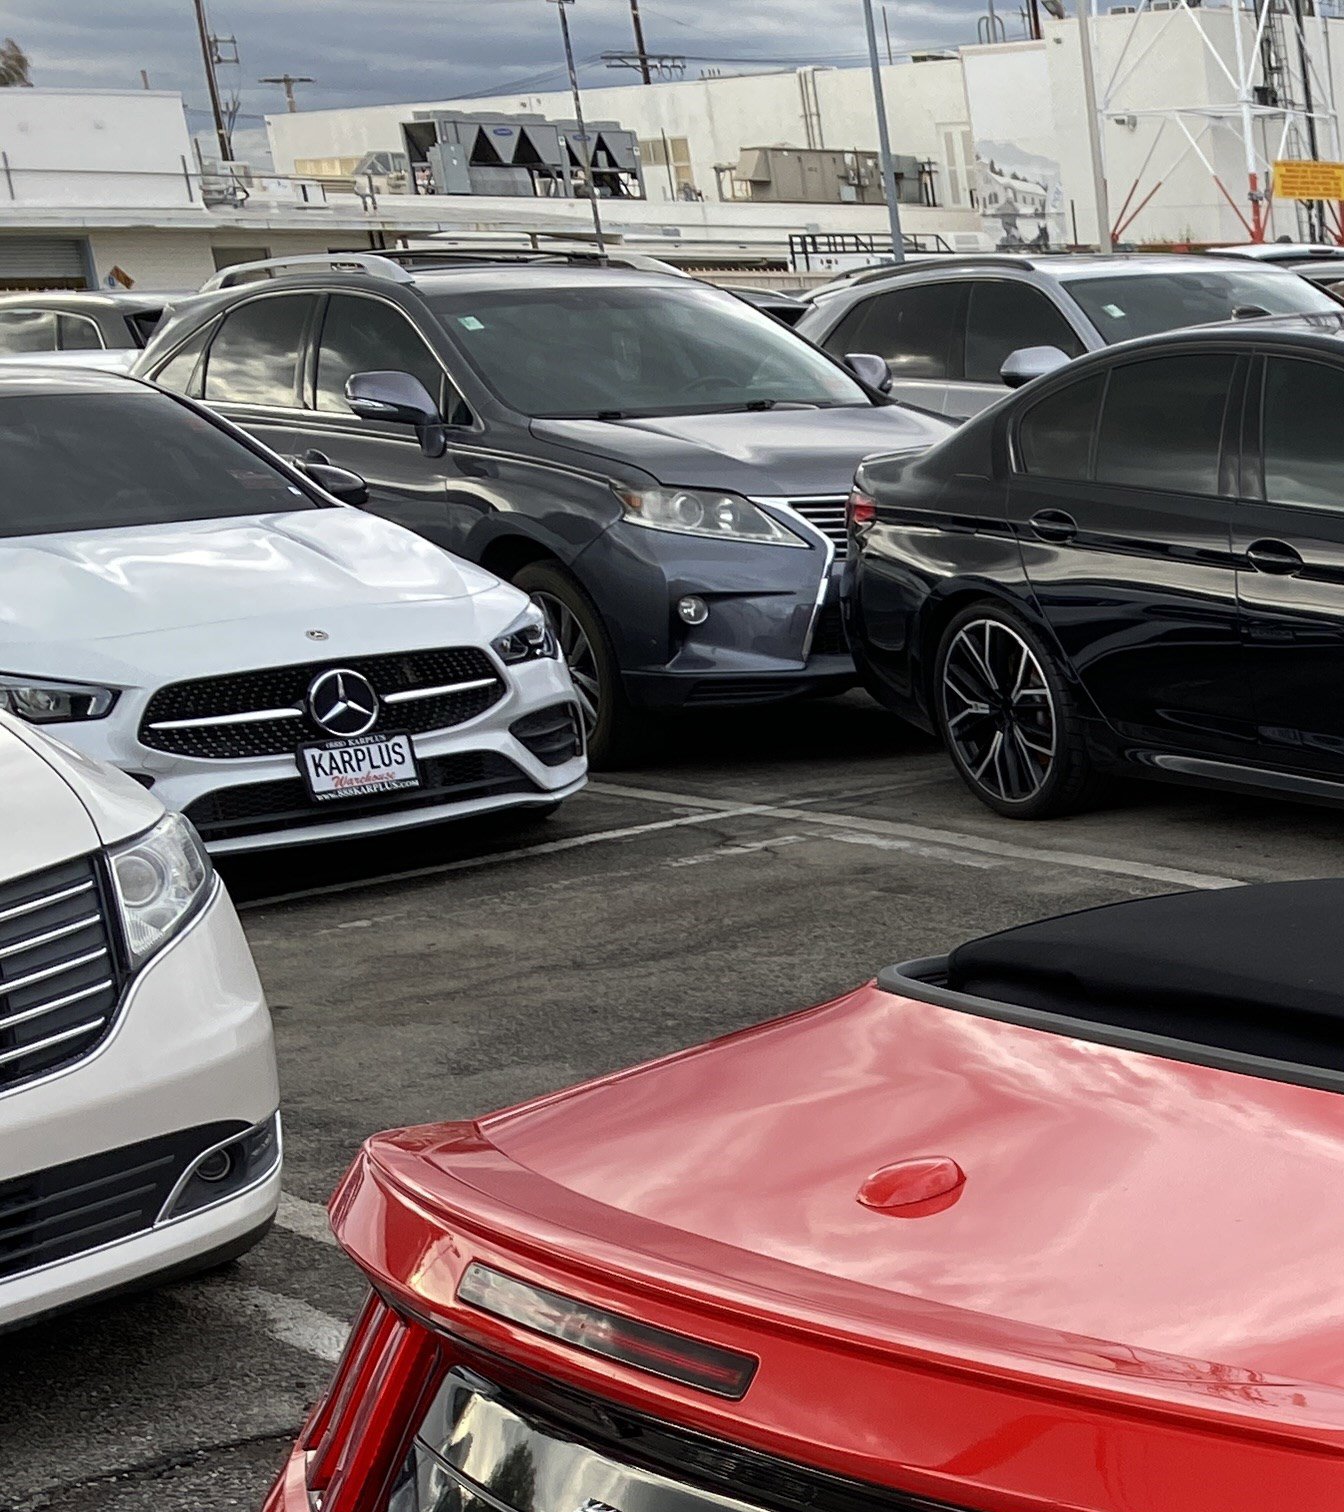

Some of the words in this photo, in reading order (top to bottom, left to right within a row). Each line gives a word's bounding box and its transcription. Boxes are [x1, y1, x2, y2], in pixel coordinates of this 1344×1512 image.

[349, 734, 387, 747] KARPLUS
[311, 742, 406, 778] KARPLUS
[332, 770, 396, 788] Warehouse
